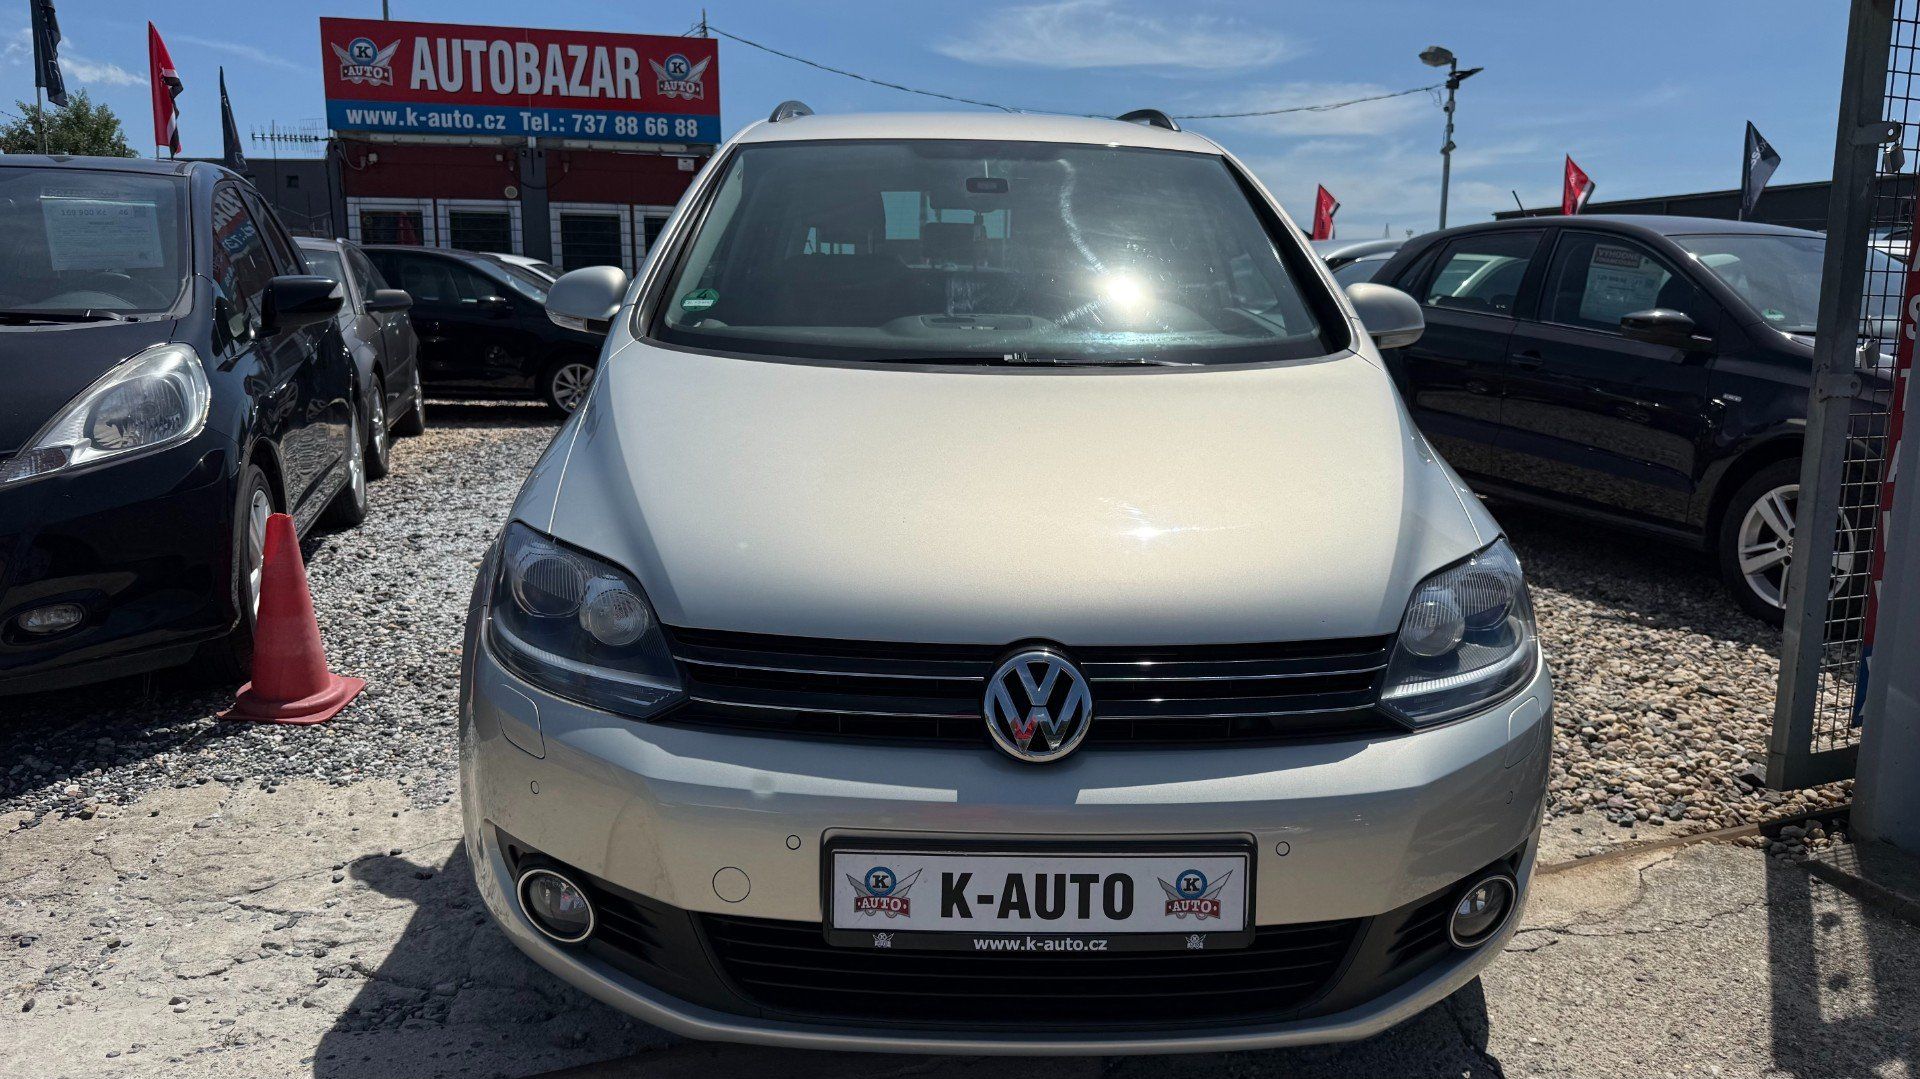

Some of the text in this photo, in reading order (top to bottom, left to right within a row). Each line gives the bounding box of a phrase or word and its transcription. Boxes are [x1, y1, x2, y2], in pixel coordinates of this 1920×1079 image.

[355, 45, 371, 59] K
[347, 65, 383, 79] AUTO
[410, 36, 642, 100] AUTOBAZAR
[671, 61, 685, 74] K
[663, 80, 695, 94] AUTO
[345, 107, 699, 138] www.k-auto.cz Tel.: 737 88 66 88
[872, 874, 889, 889] K
[1183, 877, 1200, 892] K
[940, 872, 1134, 921] K-AUTO
[861, 897, 902, 911] AUTO
[1172, 900, 1212, 913] AUTO
[973, 936, 1108, 951] www.k-auto.cz
